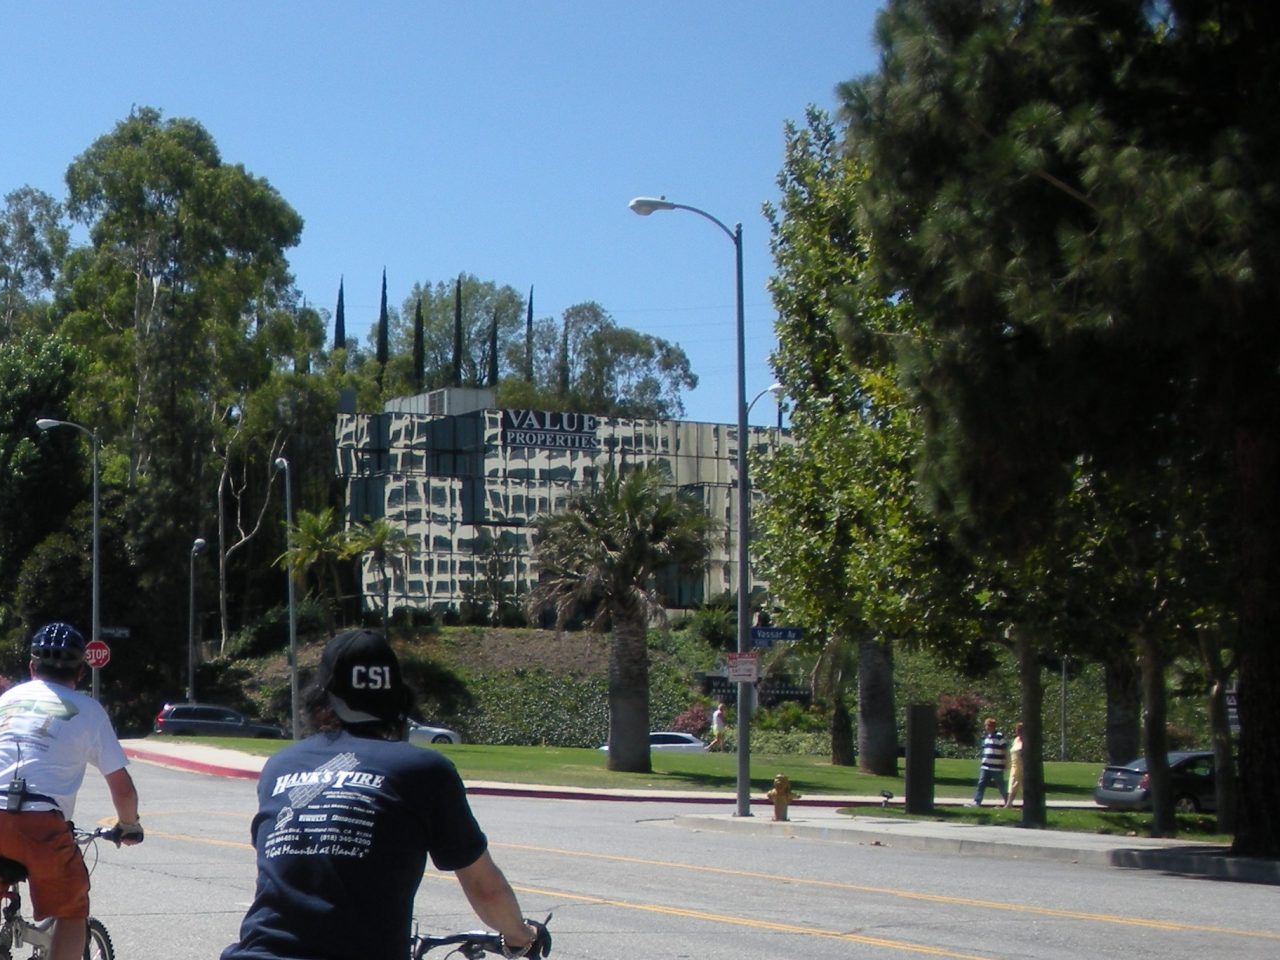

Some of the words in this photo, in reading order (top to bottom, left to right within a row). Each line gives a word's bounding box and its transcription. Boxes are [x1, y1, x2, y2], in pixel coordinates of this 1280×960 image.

[506, 408, 597, 432] VALUE
[506, 431, 598, 448] PROPERTIES
[85, 649, 108, 660] STOP
[352, 665, 392, 690] CSI
[272, 769, 333, 797] HANK'S
[331, 770, 385, 789] TIRE
[282, 844, 318, 855] Mounted
[319, 846, 329, 854] at
